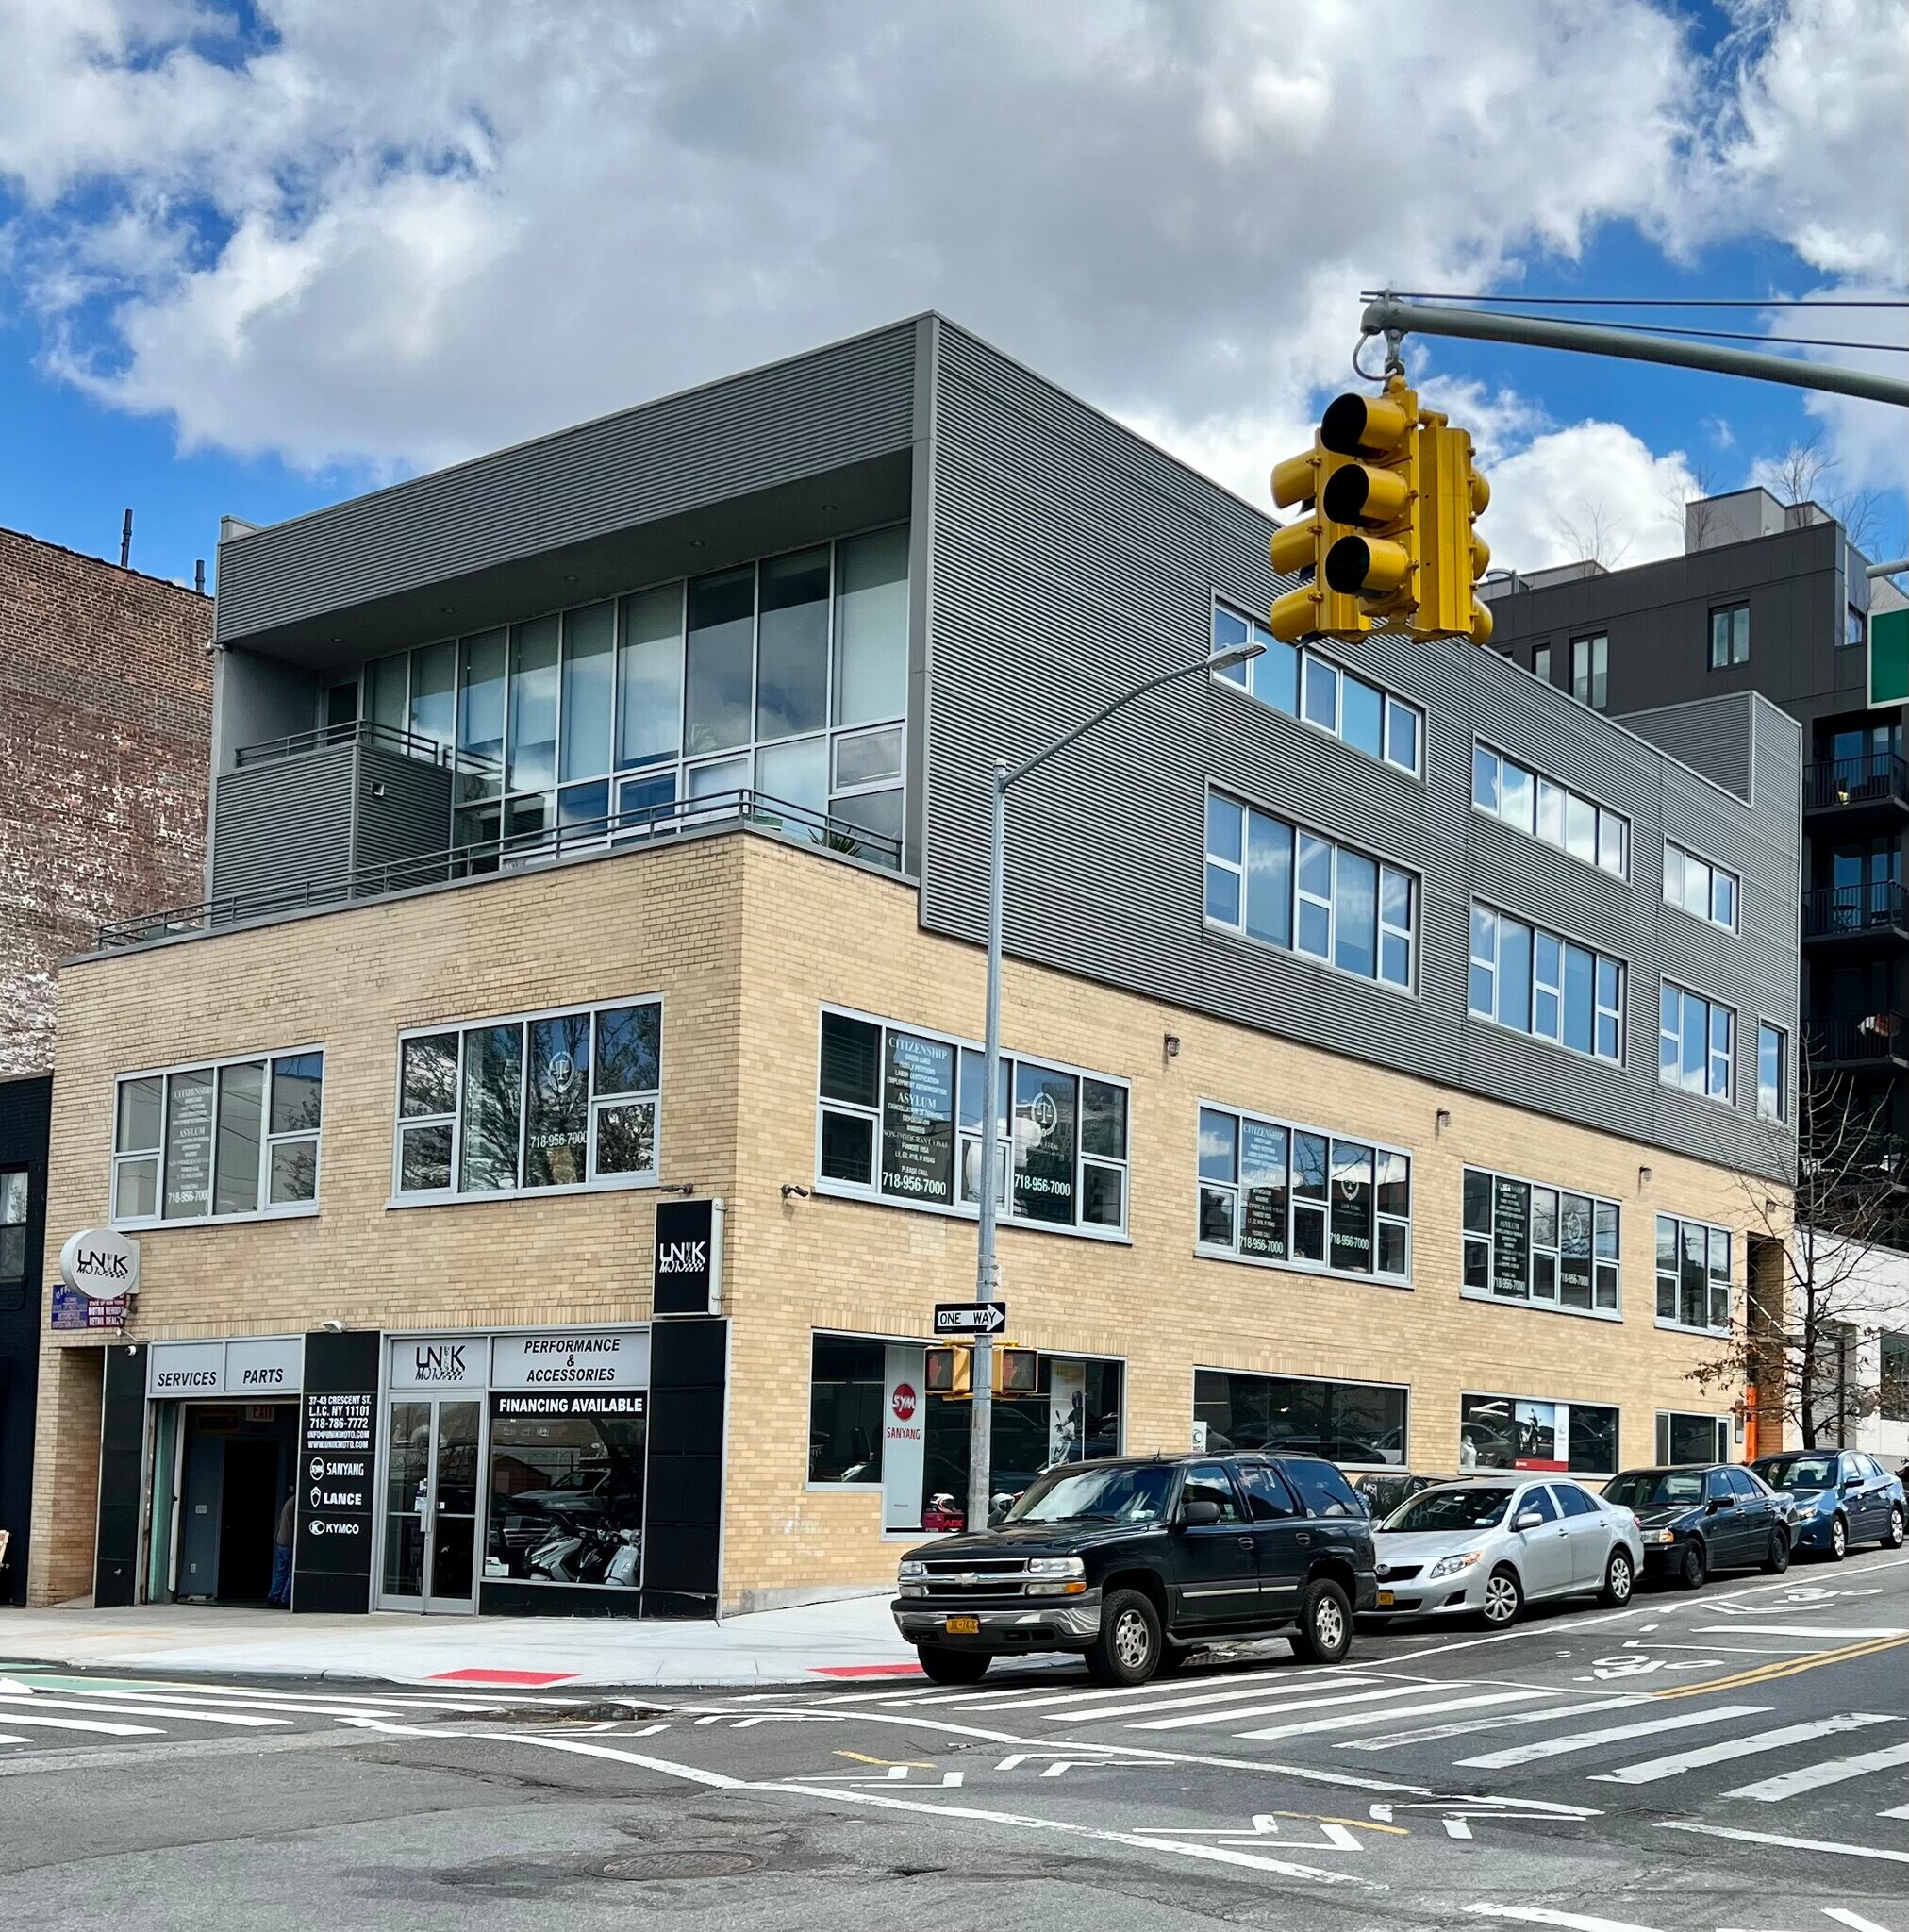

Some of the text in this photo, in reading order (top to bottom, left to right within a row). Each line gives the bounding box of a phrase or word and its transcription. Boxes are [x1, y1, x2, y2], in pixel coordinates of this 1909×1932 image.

[888, 1037, 948, 1060] CITIZENSHIP
[897, 1092, 937, 1110] ASYLUM
[1243, 1124, 1284, 1141] CITIZENSHIP
[882, 1171, 947, 1196] 718-956-7000
[1014, 1174, 1071, 1196] 718-956-7000
[940, 1311, 996, 1324] ONE WAY
[524, 1338, 620, 1355] PERFORMANCE
[566, 1355, 575, 1367] &
[158, 1371, 218, 1388] SERVICES
[242, 1368, 284, 1385] PARTS
[526, 1367, 616, 1383] ACCESSORIES
[308, 1395, 372, 1406] 37-43 CRESCENT ST.
[499, 1397, 643, 1413] FINANCING AVAILABLE
[891, 1395, 916, 1412] SYM
[308, 1405, 370, 1417] L.I.C. NY 11101
[310, 1417, 369, 1429] 718-786-7772
[887, 1427, 921, 1440] SANYANG
[307, 1440, 369, 1450] WWW.UNIKMOTO.COM
[326, 1462, 364, 1477] SANYANG
[323, 1493, 362, 1506] LANCE
[325, 1523, 360, 1536] KYMCO
